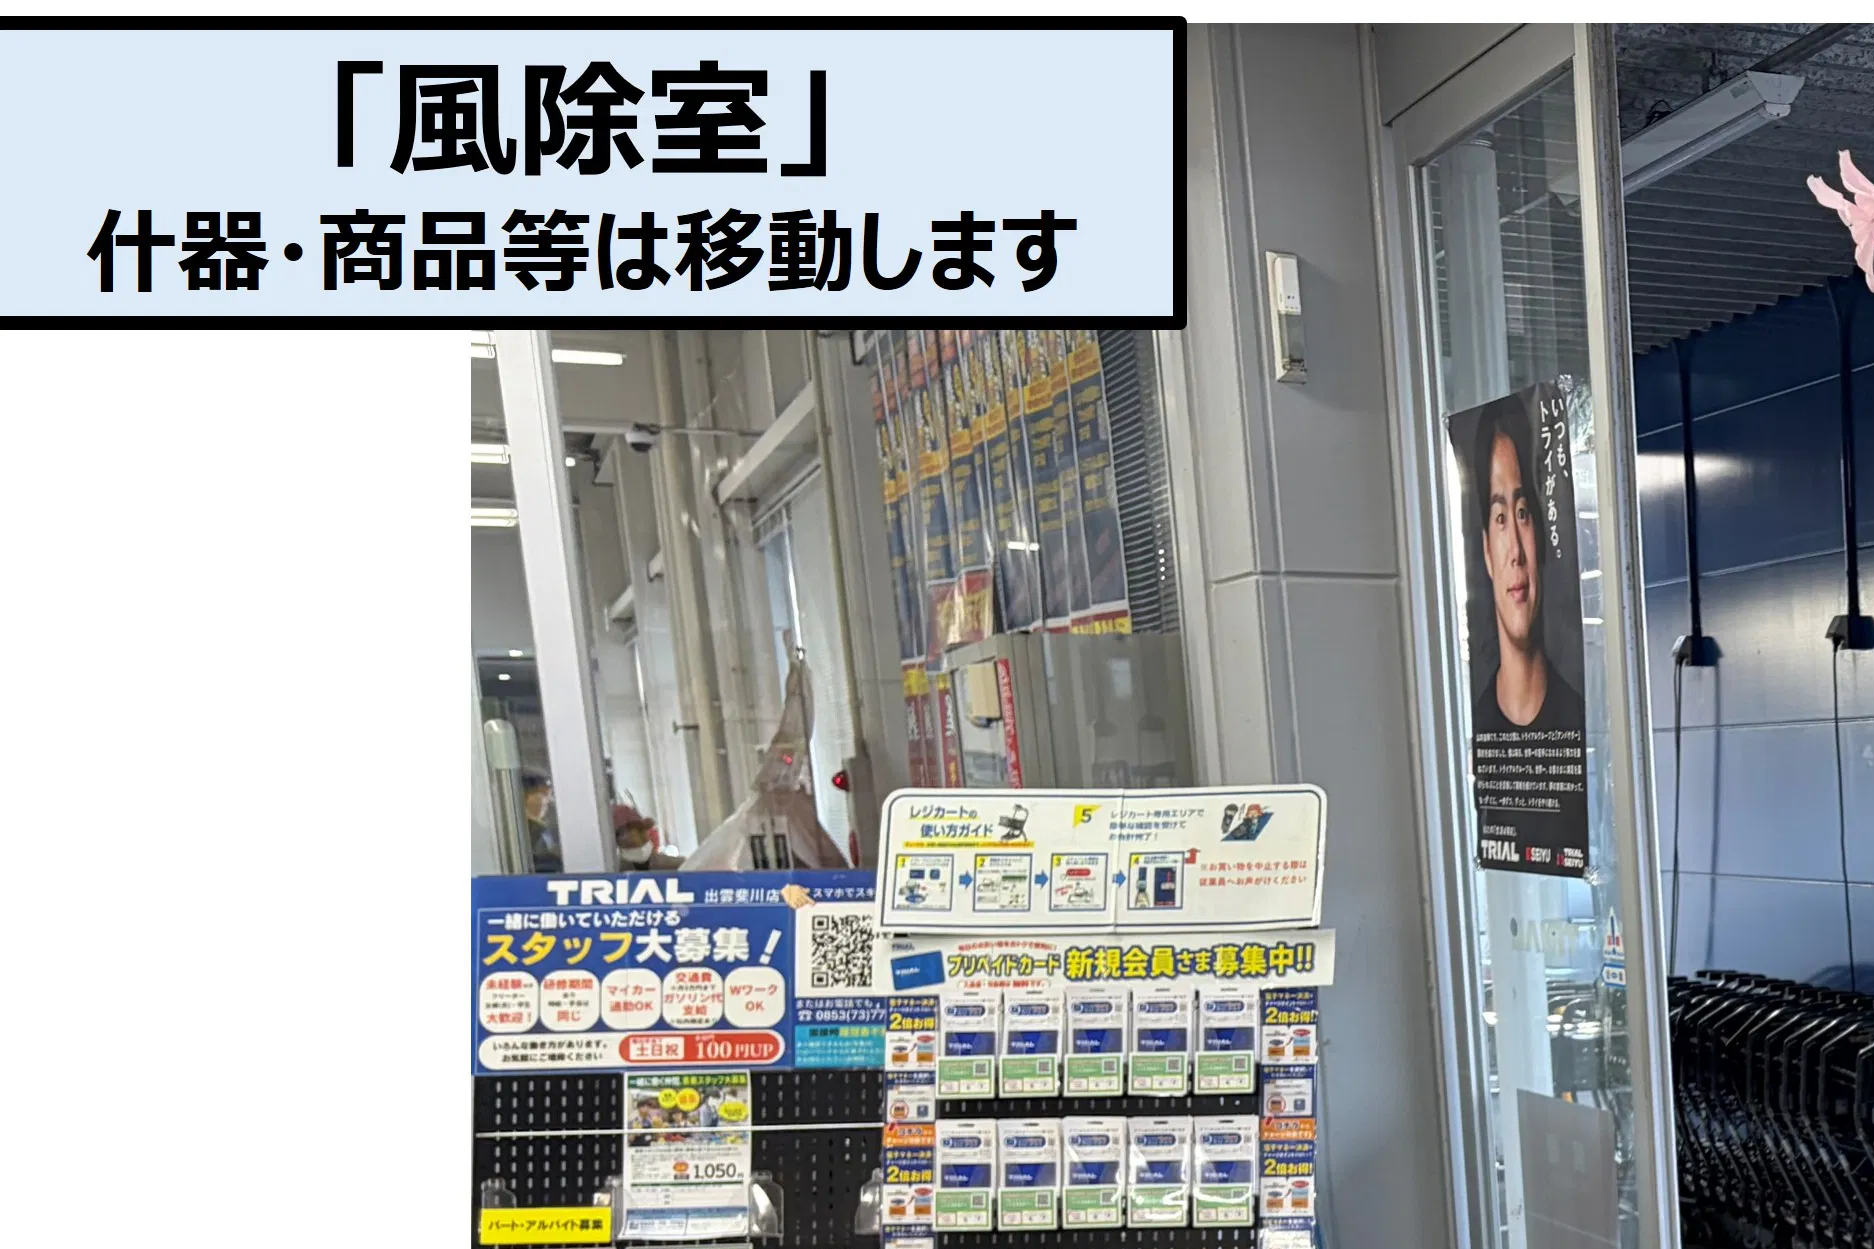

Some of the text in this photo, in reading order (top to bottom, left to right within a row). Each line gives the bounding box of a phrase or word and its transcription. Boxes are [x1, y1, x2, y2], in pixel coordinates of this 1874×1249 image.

[1539, 400, 1562, 559] トライがある。
[910, 804, 978, 819] レジカートの
[1080, 808, 1093, 824] 5
[921, 824, 994, 839] 使い方ガイド
[1480, 839, 1520, 863] TRIAL
[546, 878, 695, 906] TRIAL
[487, 910, 681, 930] 一緒に働いていただける
[948, 952, 1062, 978] プリペイドカード
[606, 984, 656, 997] マイカー
[745, 1001, 764, 1012] OK
[635, 1043, 680, 1058] 土日祝
[488, 1217, 604, 1233] パート・アルバイト募集
